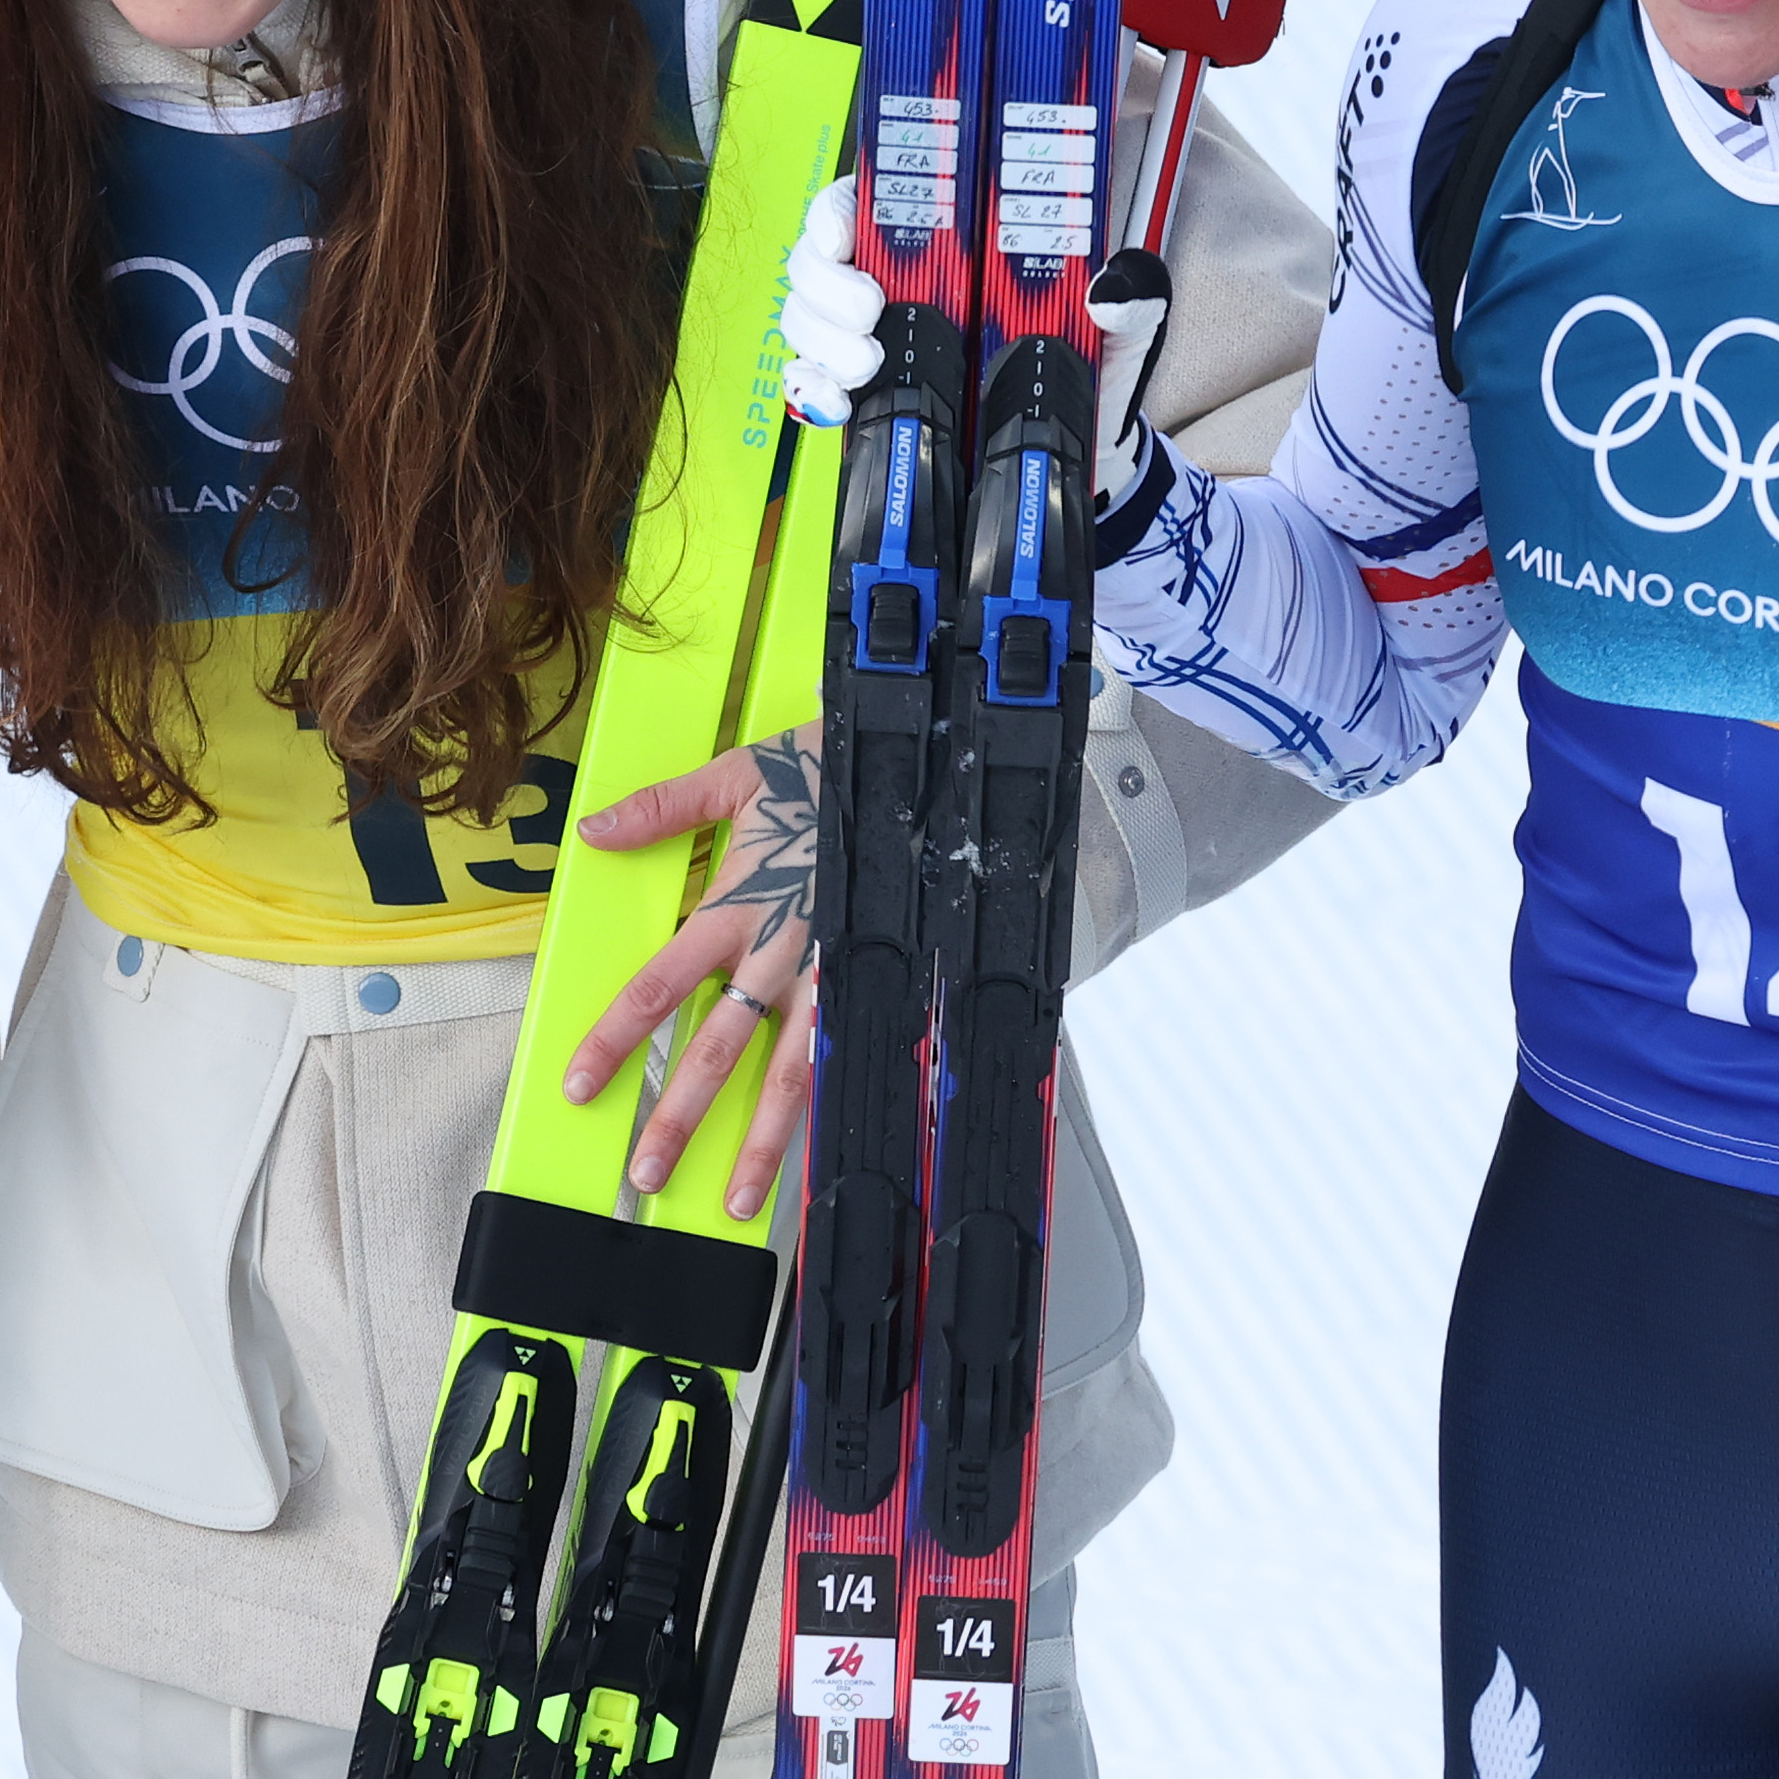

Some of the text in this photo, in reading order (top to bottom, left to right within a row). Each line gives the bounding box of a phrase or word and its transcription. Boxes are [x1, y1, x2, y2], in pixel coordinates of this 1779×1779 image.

[890, 425, 913, 527] SALOMON
[1020, 458, 1042, 559] SALOMON
[1505, 538, 1673, 610] MILANO
[817, 1574, 877, 1613] 1/4
[936, 1618, 996, 1658] 1/4
